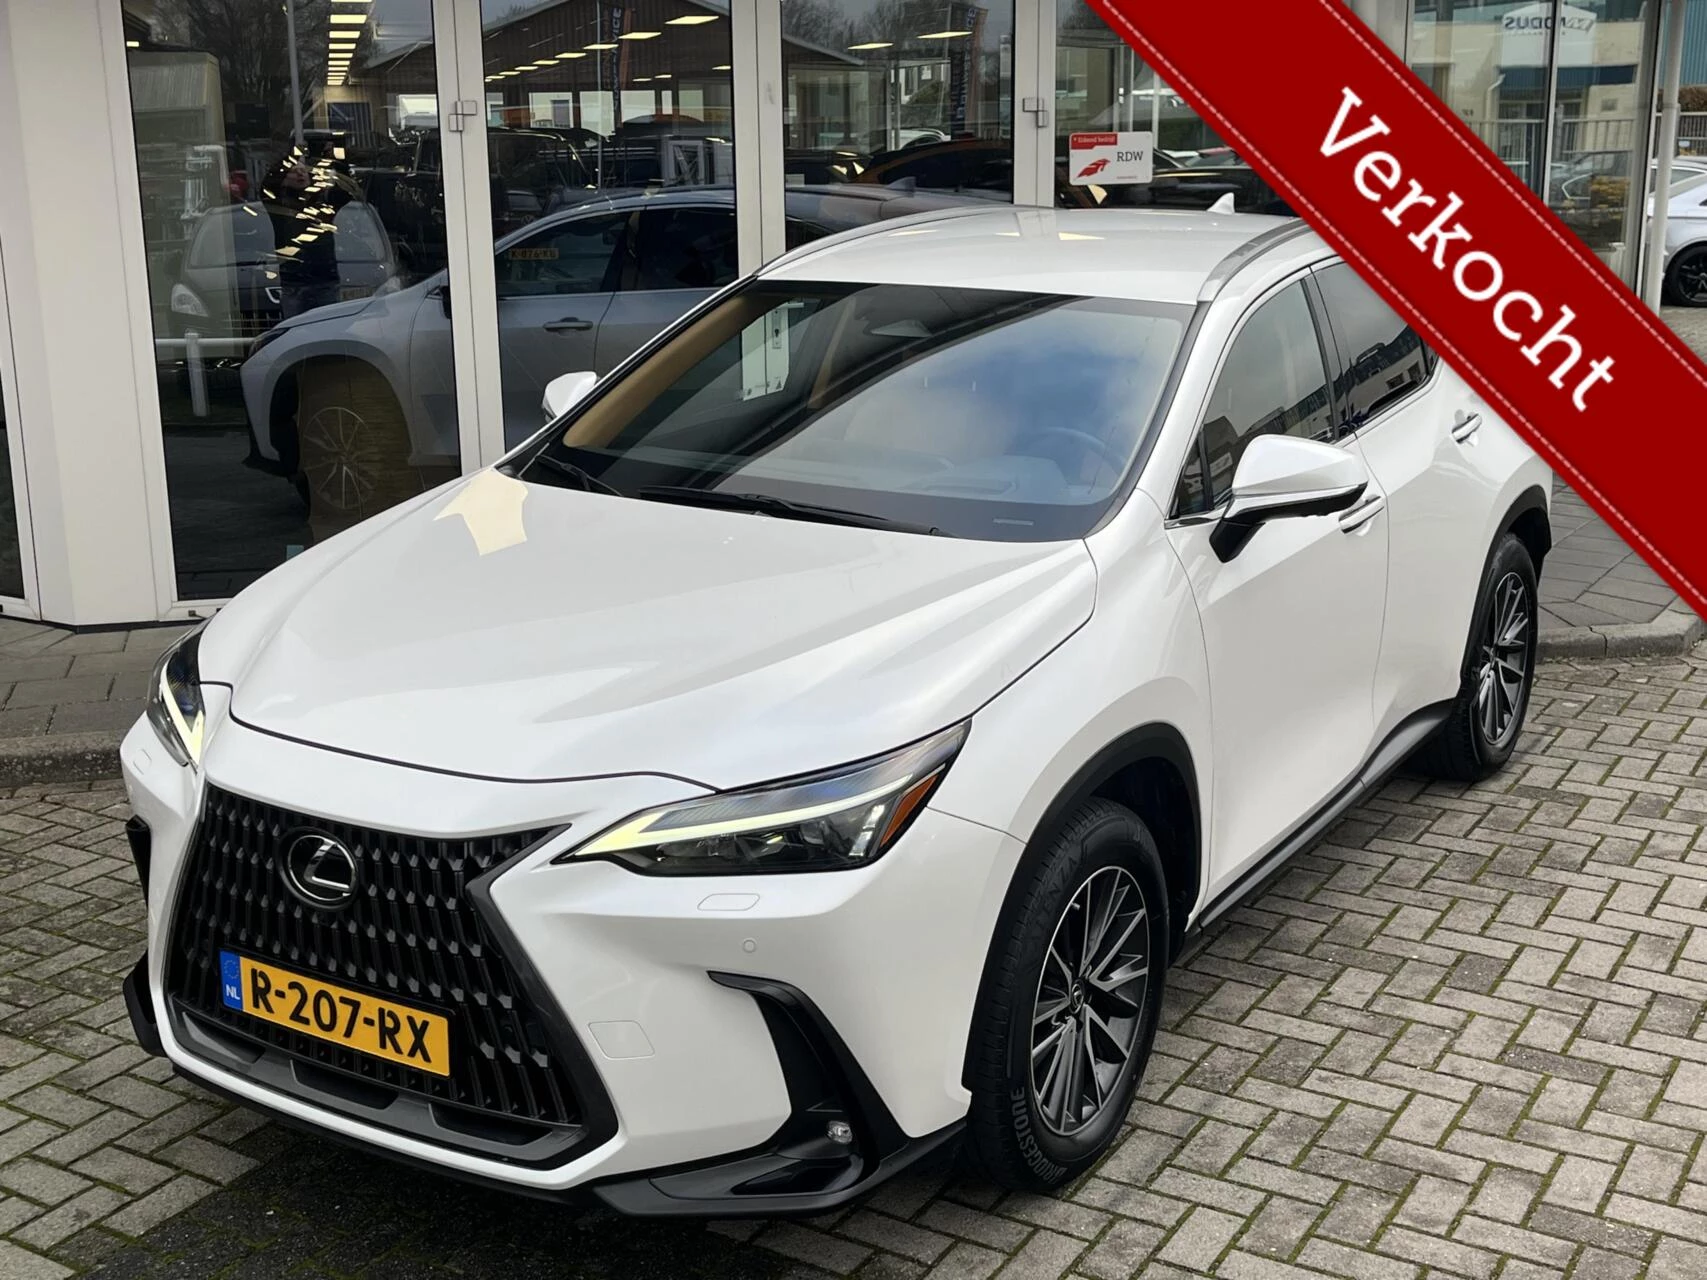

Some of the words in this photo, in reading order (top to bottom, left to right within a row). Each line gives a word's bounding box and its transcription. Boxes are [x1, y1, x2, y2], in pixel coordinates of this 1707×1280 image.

[1117, 151, 1144, 162] RDW
[225, 983, 240, 1000] NL
[251, 967, 432, 1064] R-207-RX
